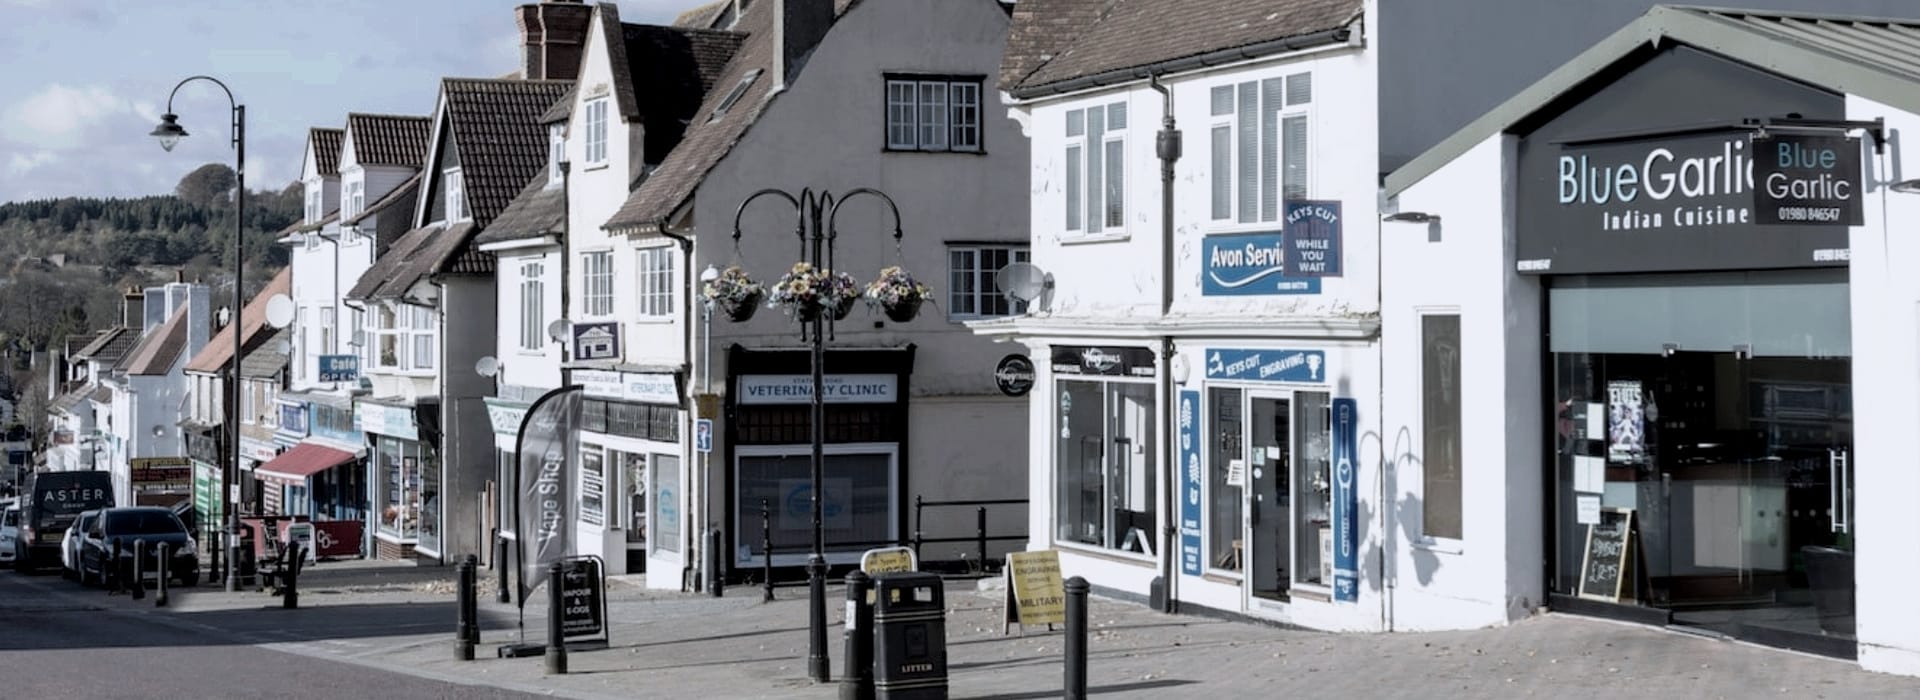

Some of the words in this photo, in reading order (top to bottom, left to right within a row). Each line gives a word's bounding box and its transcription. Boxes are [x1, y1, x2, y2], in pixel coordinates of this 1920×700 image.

[1778, 142, 1837, 169] Blue
[1766, 172, 1851, 200] Garlic
[1287, 206, 1313, 225] KEYS
[1315, 207, 1338, 224] CUT
[1603, 211, 1662, 231] Indian
[1673, 205, 1748, 227] Cuisine
[1778, 207, 1807, 221] 01980
[1808, 207, 1840, 221] 846547
[1295, 239, 1329, 249] WHILE
[1210, 245, 1243, 267] Avon
[1245, 242, 1283, 267] Servi
[1300, 251, 1325, 261] YOU
[1298, 262, 1326, 272] WAIT
[1226, 361, 1245, 377] KEYS
[1245, 353, 1261, 370] CUT
[1259, 352, 1305, 378] ENGRAVING
[839, 384, 887, 396] CLINIC
[538, 451, 564, 495] Shop
[44, 488, 104, 502] ASTER
[538, 500, 562, 542] Vape
[1020, 596, 1063, 608] MILITARY
[901, 663, 933, 673] LITTER
